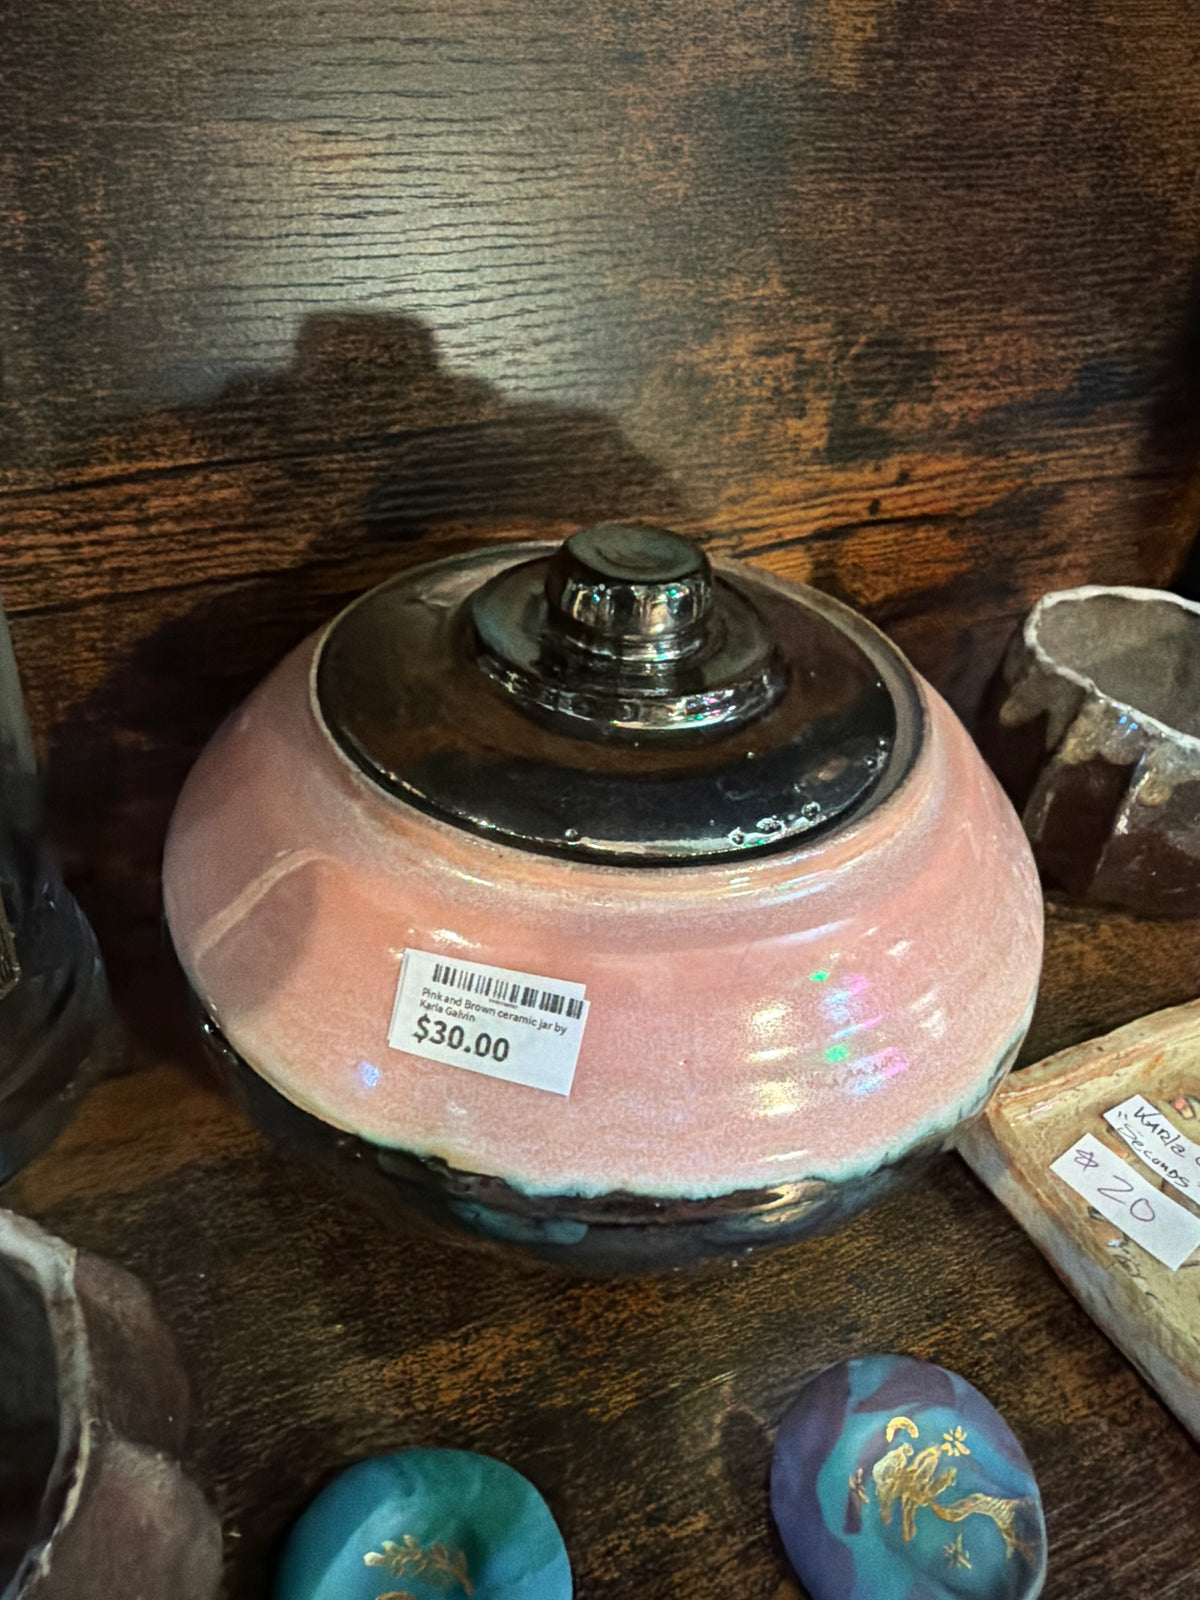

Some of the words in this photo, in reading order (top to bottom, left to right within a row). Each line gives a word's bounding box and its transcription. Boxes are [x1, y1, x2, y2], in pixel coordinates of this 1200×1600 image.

[420, 999, 443, 1014] Karla
[445, 1007, 476, 1023] Galvin
[422, 988, 442, 1003] Pink
[444, 996, 462, 1008] and
[465, 999, 496, 1015] Brown
[497, 1009, 537, 1026] ceramic
[537, 1017, 553, 1032] jar
[554, 1023, 567, 1036] by
[412, 1013, 510, 1062] $30.00
